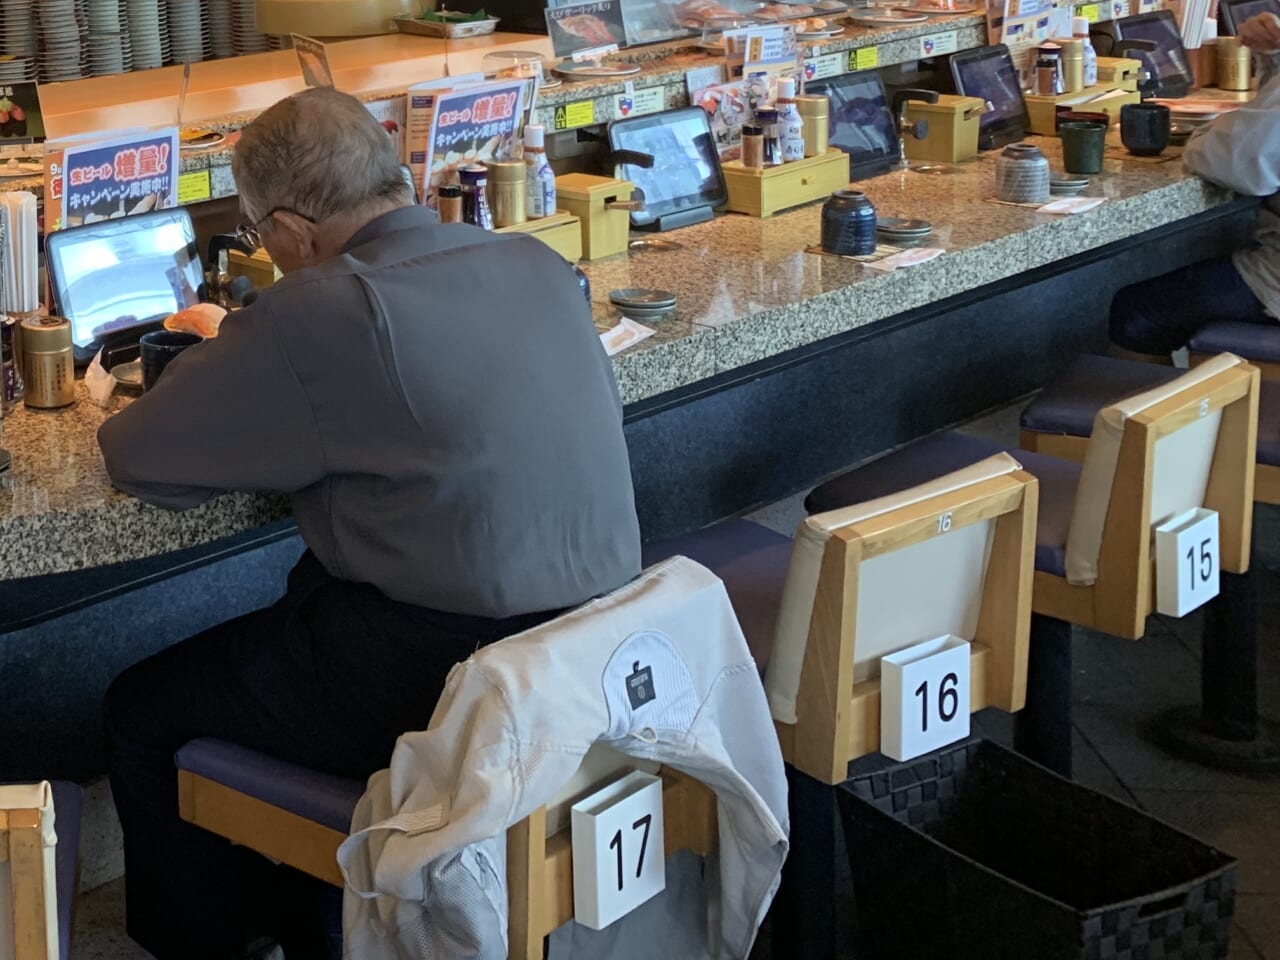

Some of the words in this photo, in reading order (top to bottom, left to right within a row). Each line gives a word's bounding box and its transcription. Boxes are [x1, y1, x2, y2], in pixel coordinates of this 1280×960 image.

[937, 511, 952, 534] 16
[1186, 537, 1213, 591] 15
[915, 672, 959, 732] 16
[609, 814, 652, 892] 17
